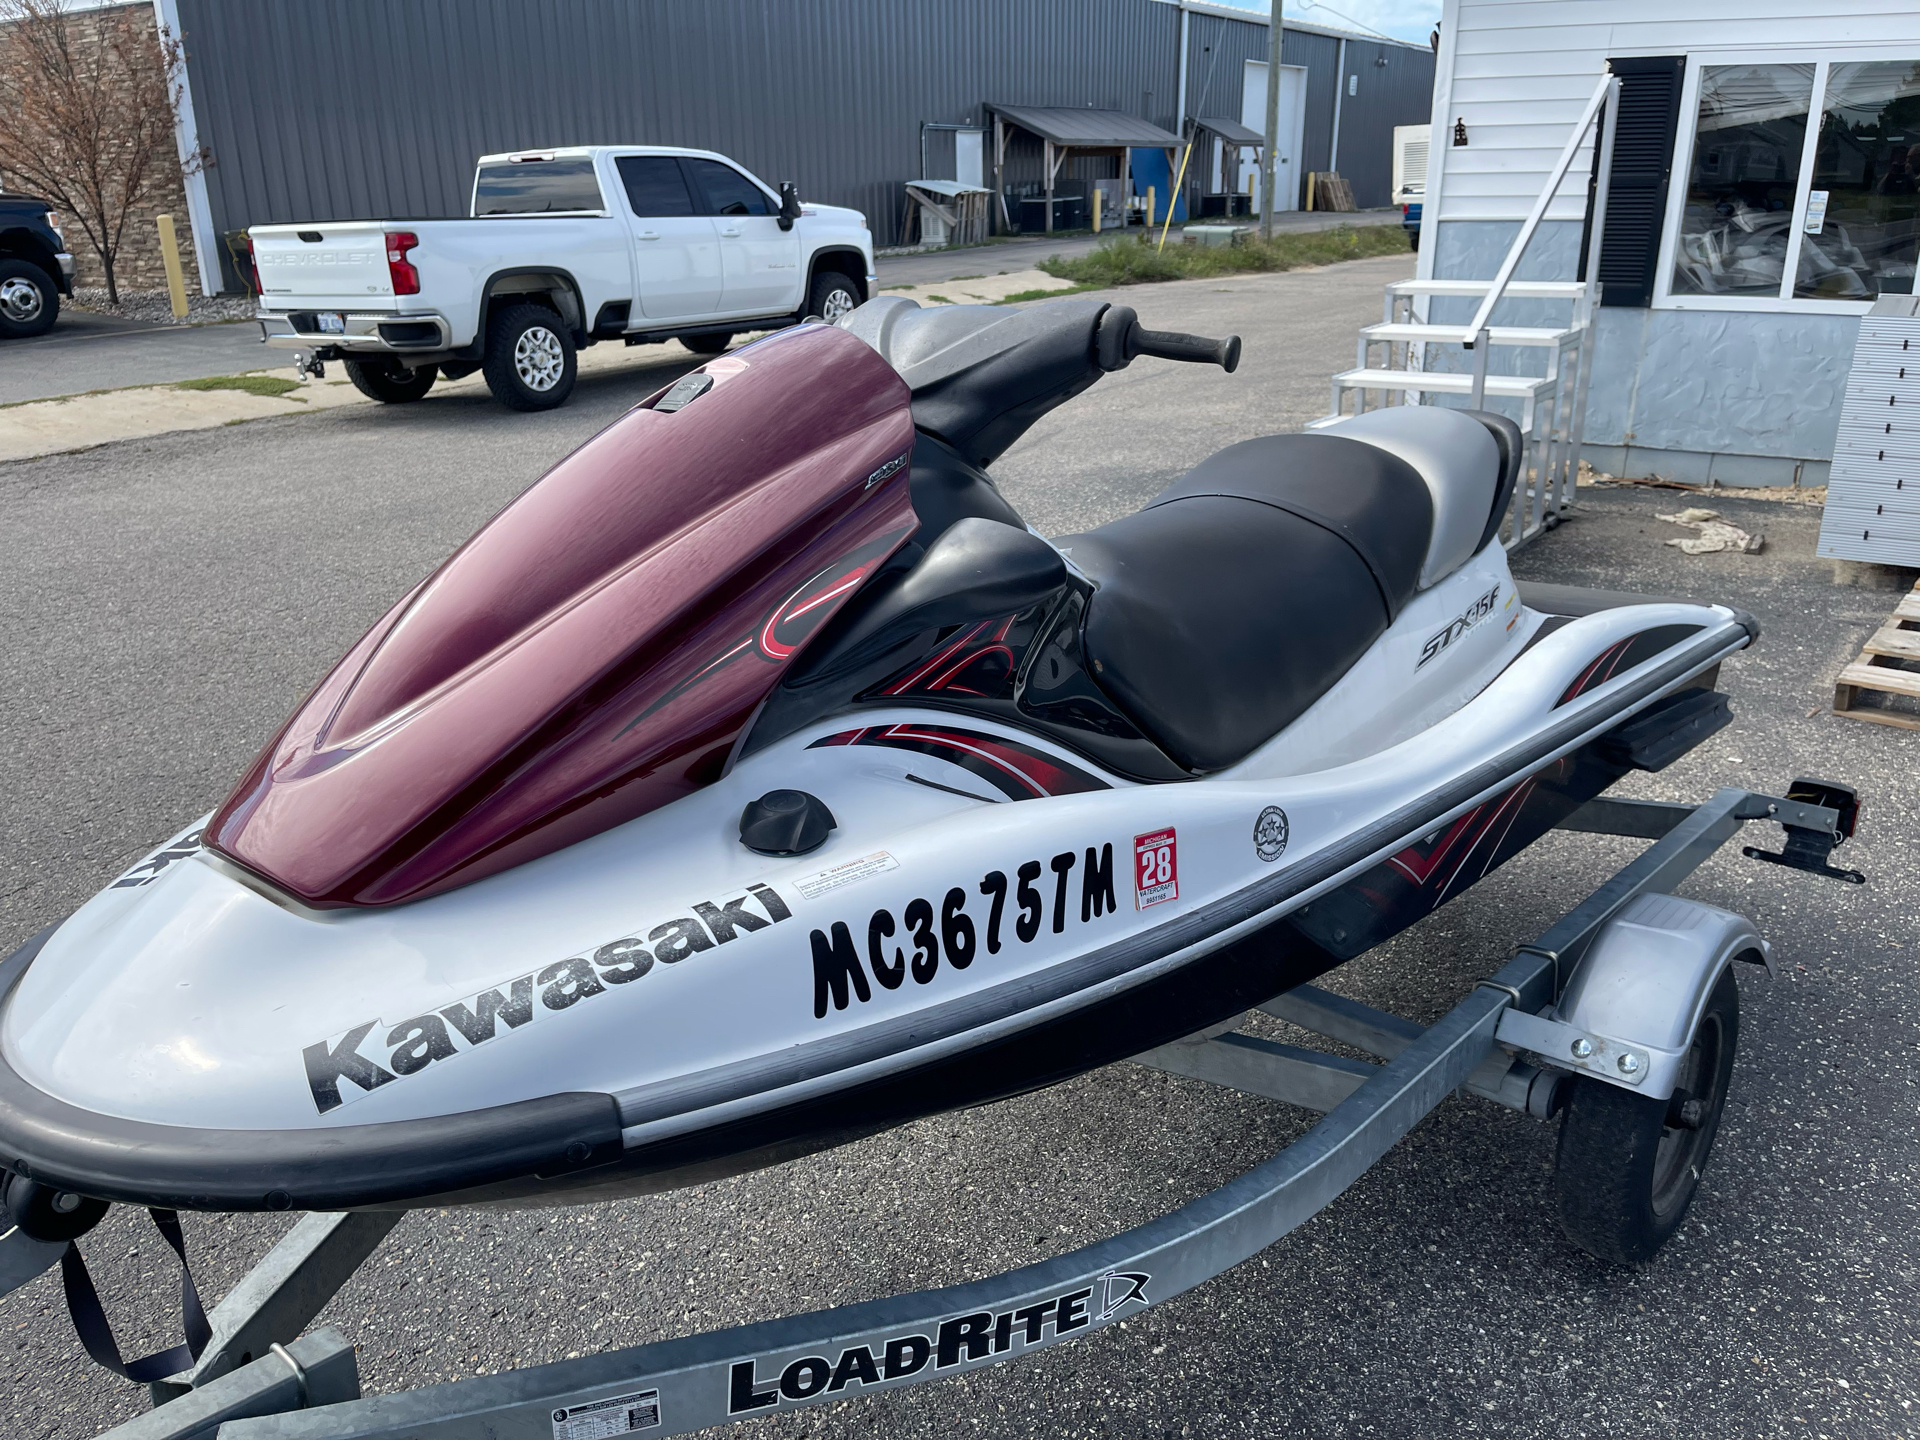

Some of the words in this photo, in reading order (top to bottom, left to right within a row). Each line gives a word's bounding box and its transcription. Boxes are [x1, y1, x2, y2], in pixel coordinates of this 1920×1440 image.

[261, 252, 376, 267] CHEVROLET
[1145, 834, 1167, 845] MICHIGAN
[1258, 845, 1286, 861] EMISSION
[830, 859, 865, 873] WARNING
[1142, 846, 1171, 888] 28
[810, 842, 1117, 1019] MC3675TM
[302, 882, 793, 1115] Kawasaki
